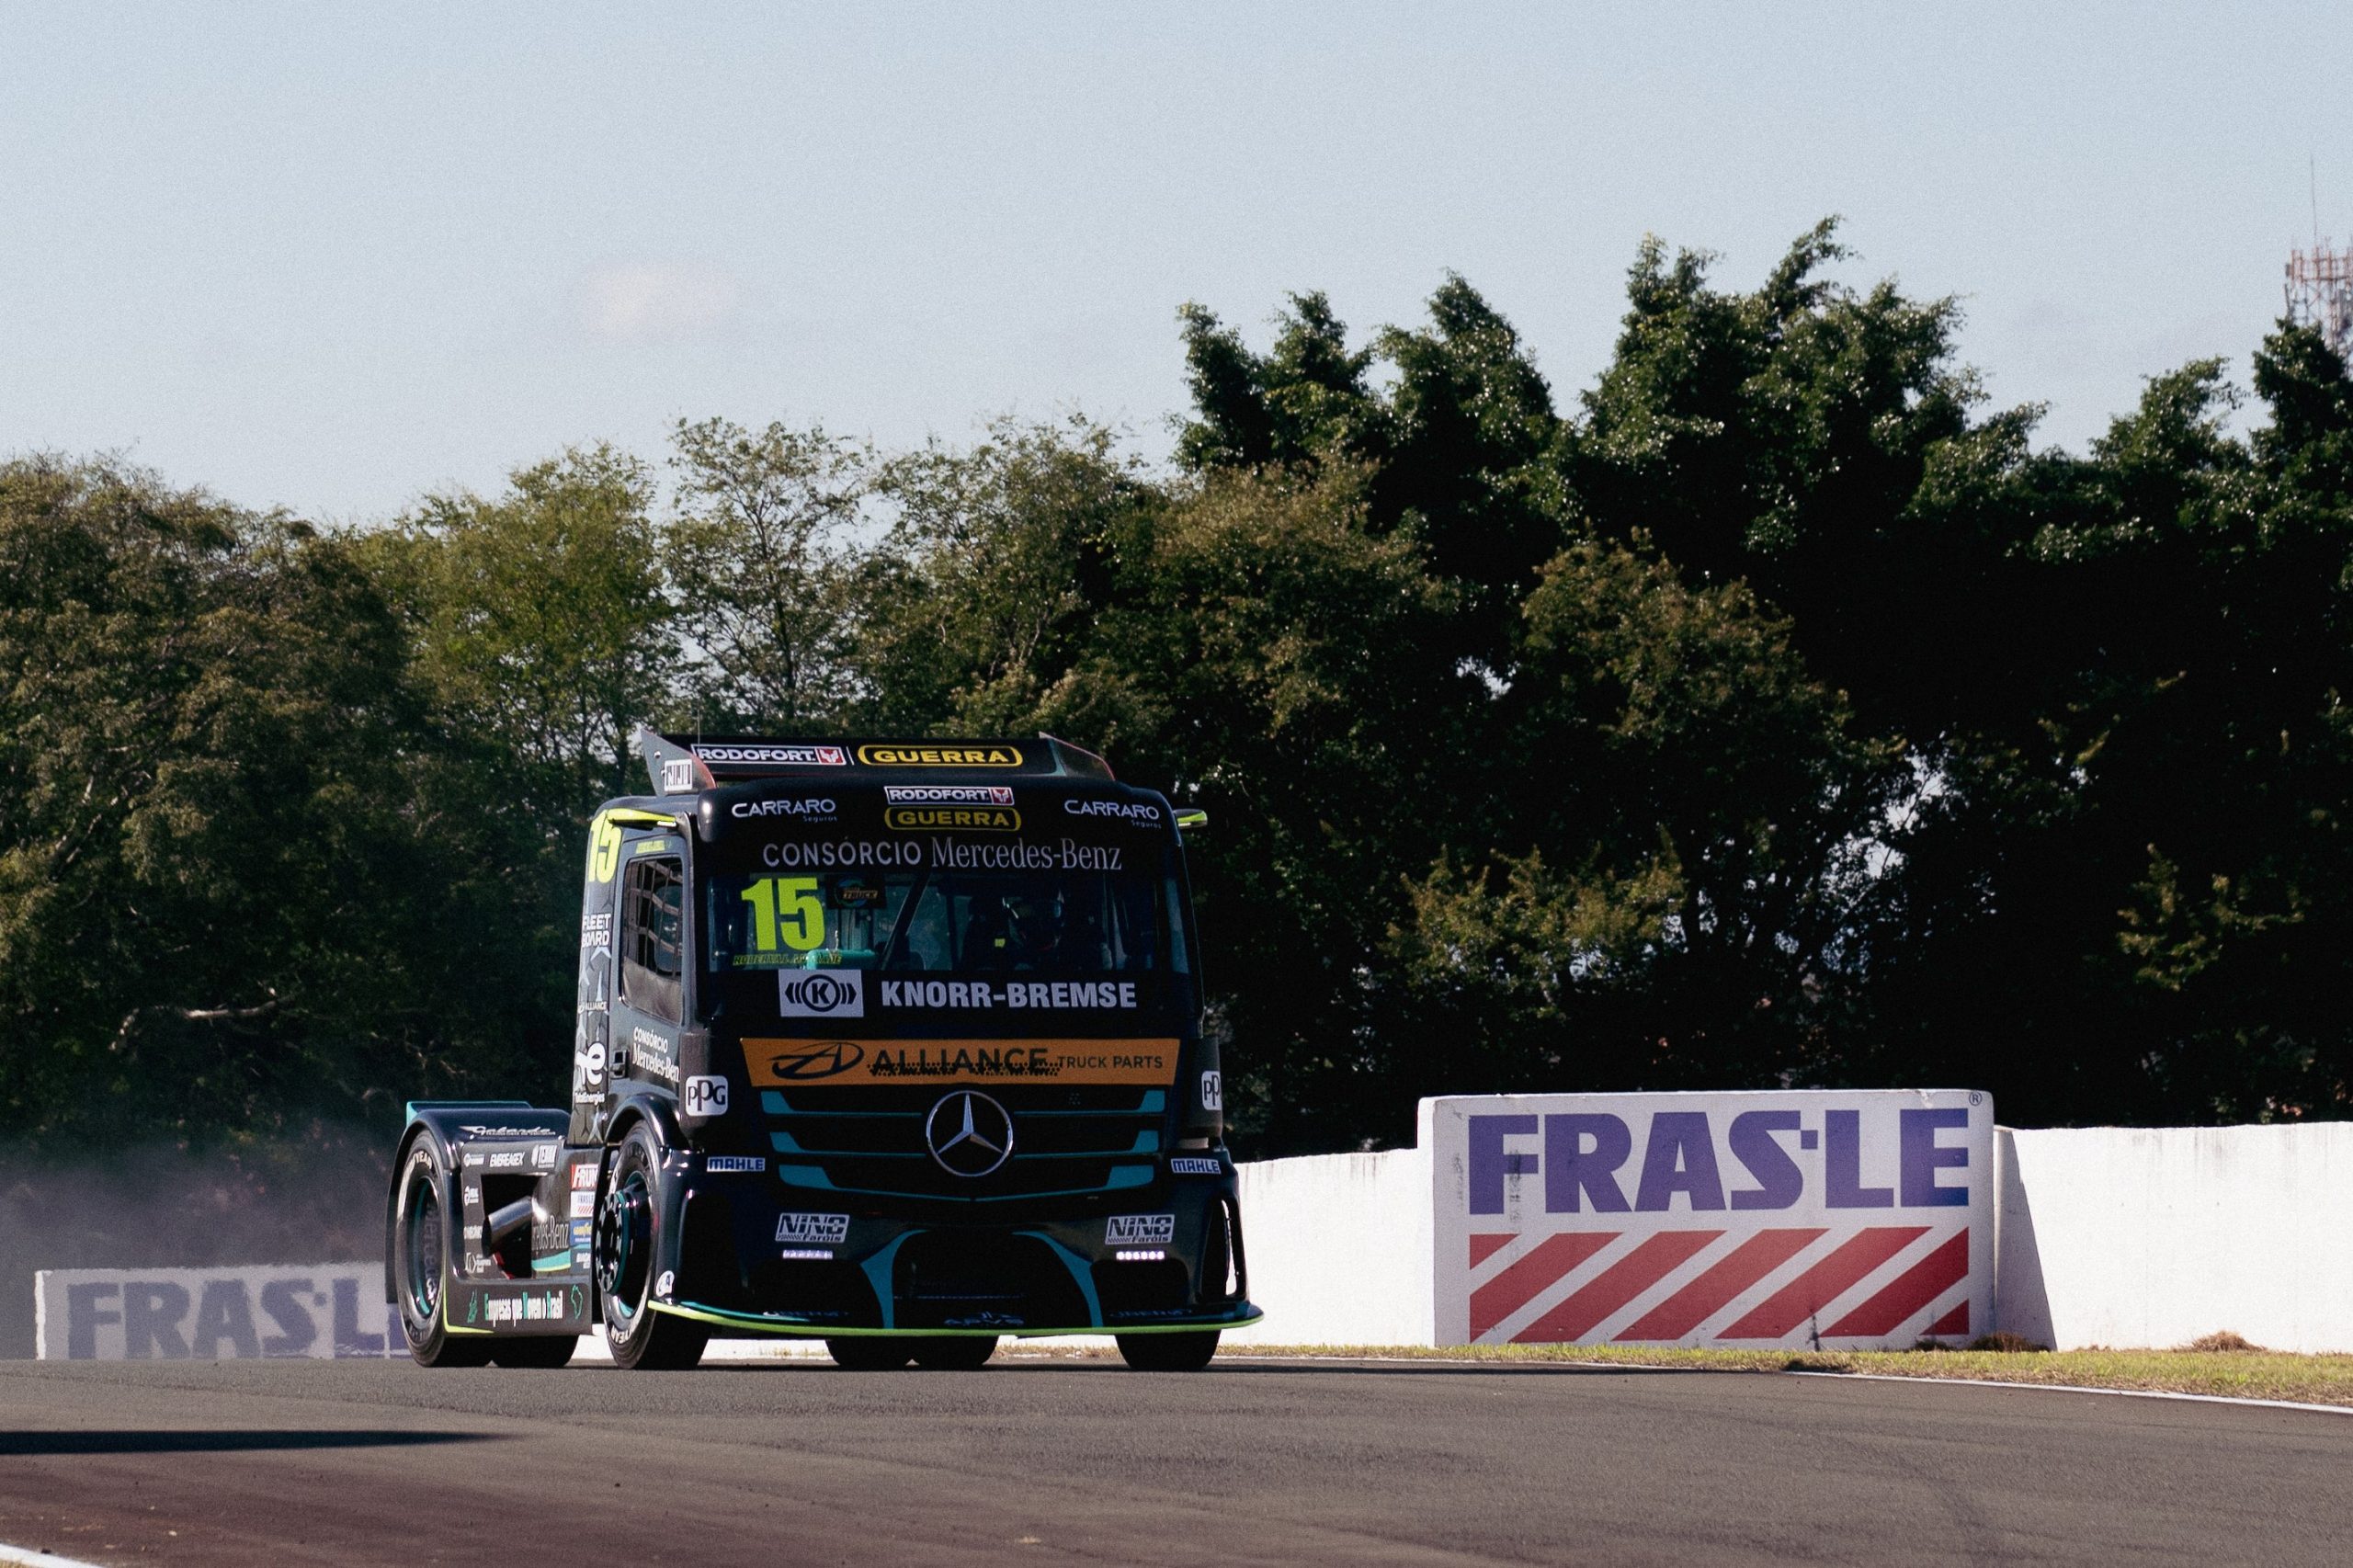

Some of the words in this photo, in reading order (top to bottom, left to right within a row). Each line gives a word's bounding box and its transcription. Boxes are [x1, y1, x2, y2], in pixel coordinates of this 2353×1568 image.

[698, 748, 814, 762] RODOFORT
[873, 750, 1009, 763] GUERRA
[889, 789, 988, 801] RODOFORT
[732, 799, 836, 818] CARRARO
[1064, 800, 1160, 820] CARRARO
[897, 811, 1009, 826] GUERRA
[763, 836, 922, 867] CONSÓRCIO
[931, 836, 1122, 870] Mercedes-Benz
[583, 914, 612, 930] FLEET
[741, 878, 825, 951] 15
[581, 930, 610, 949] BOARD
[881, 980, 1137, 1007] KNORR-BREMSE
[632, 1042, 680, 1083] Mercedes-Ben
[873, 1047, 1049, 1076] ALLIANCE
[1059, 1056, 1108, 1068] TRUCK
[1113, 1055, 1163, 1069] PARTS
[709, 1158, 764, 1170] MAHLE
[1173, 1159, 1220, 1173] MAHLE
